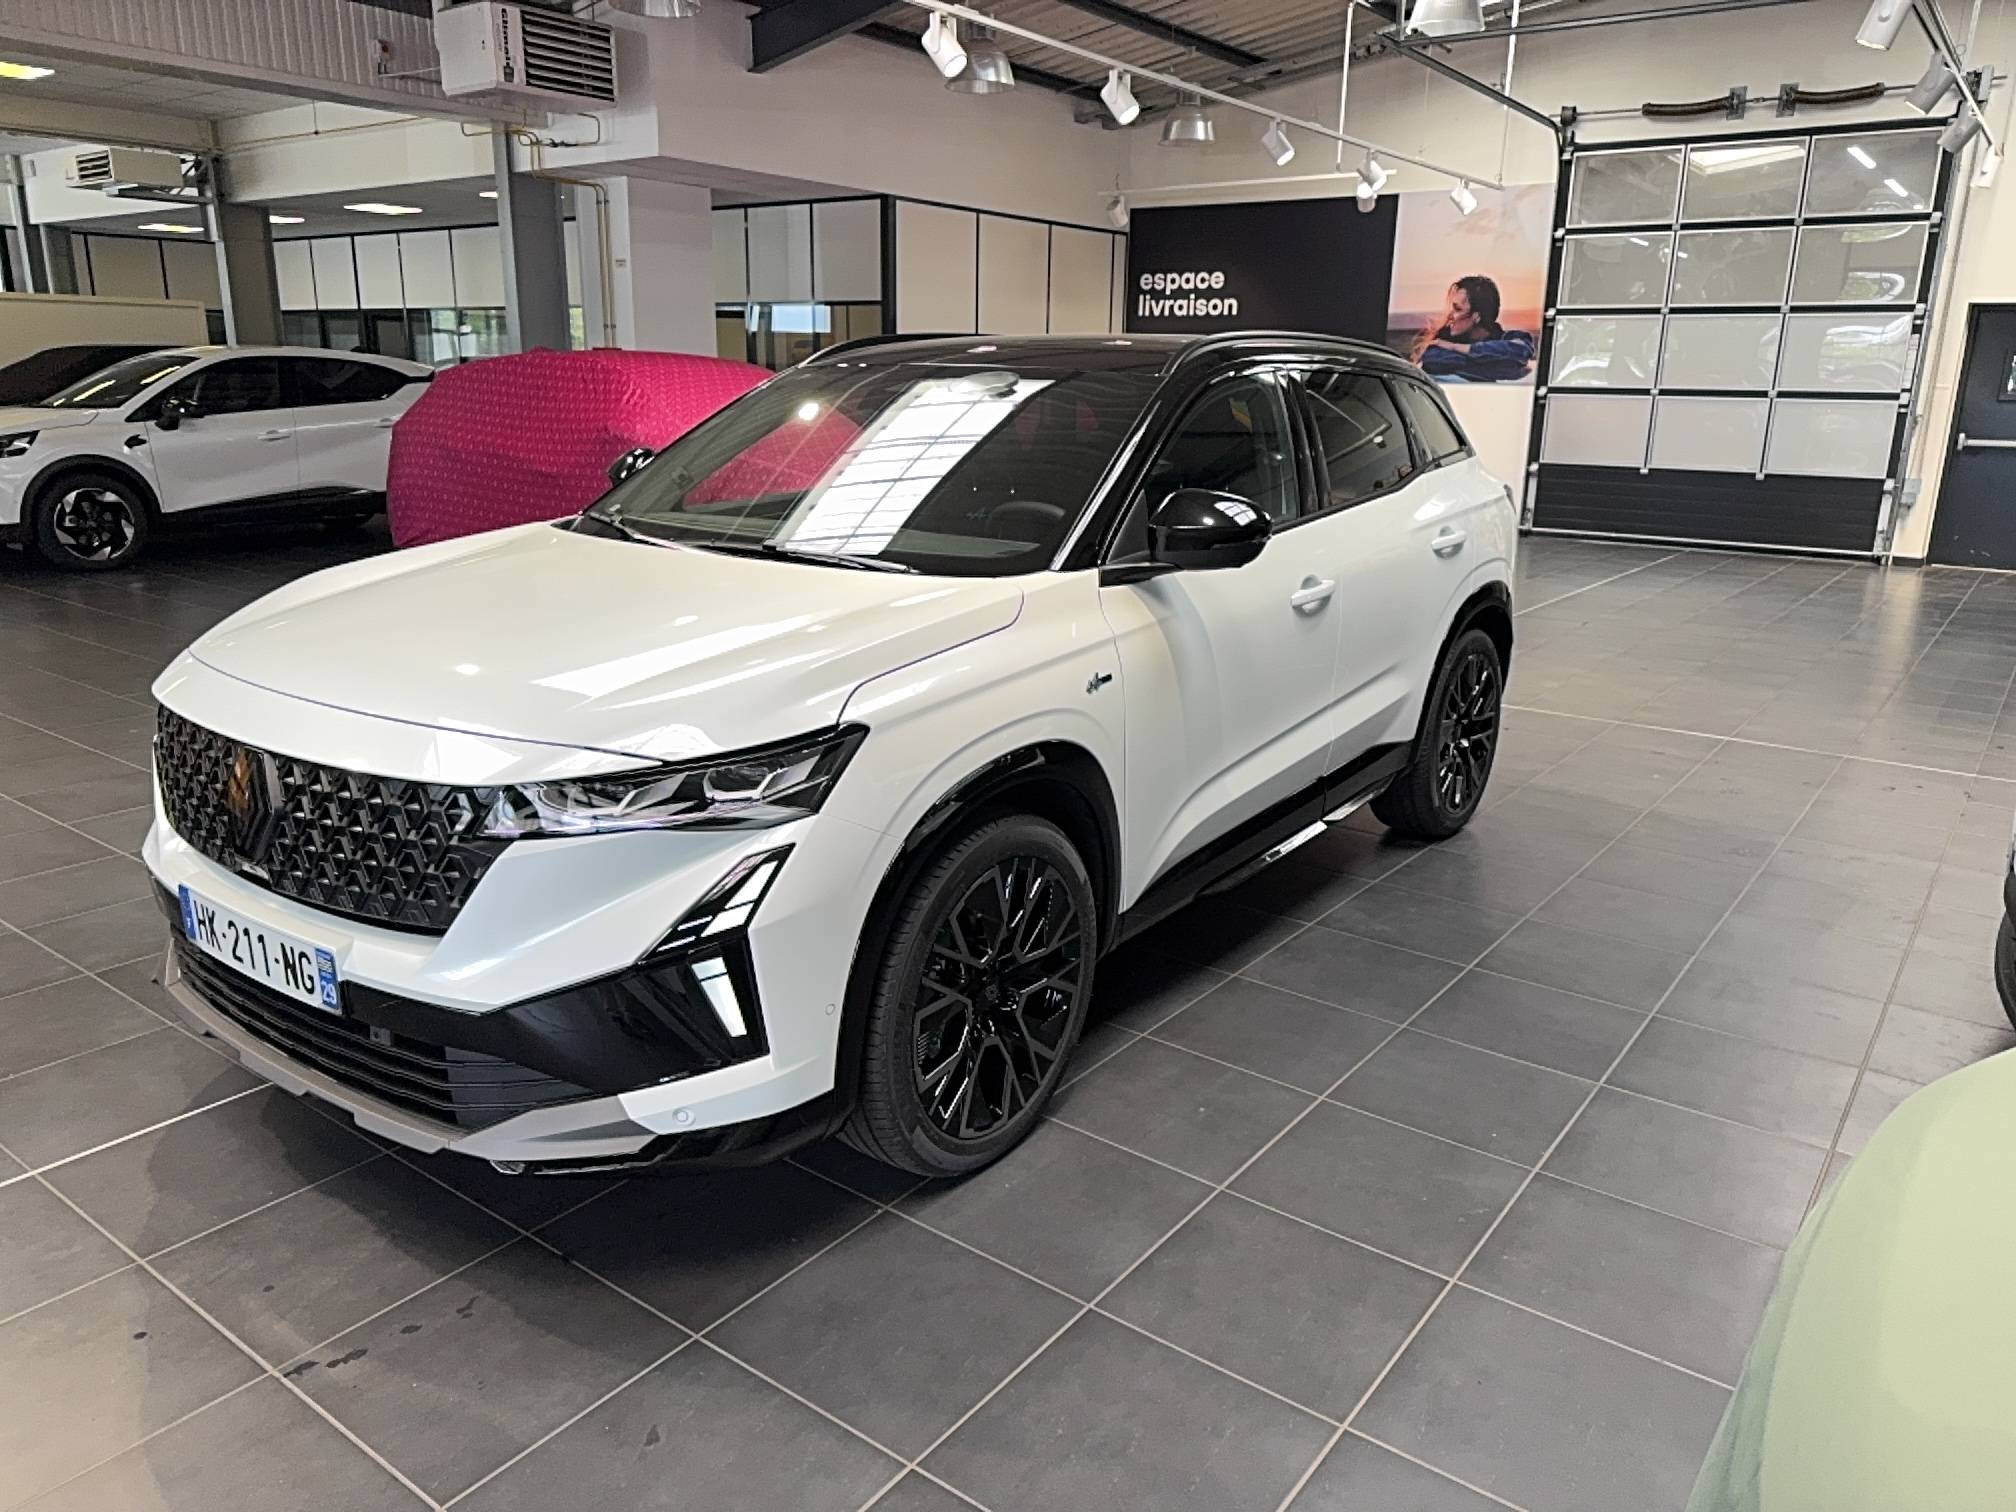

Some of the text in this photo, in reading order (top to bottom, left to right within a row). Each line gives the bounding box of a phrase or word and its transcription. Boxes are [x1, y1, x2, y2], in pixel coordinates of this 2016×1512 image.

[1139, 271, 1225, 295] espace
[1137, 293, 1238, 317] livraison
[193, 900, 316, 995] HK-211-NG
[321, 980, 337, 1005] 29
